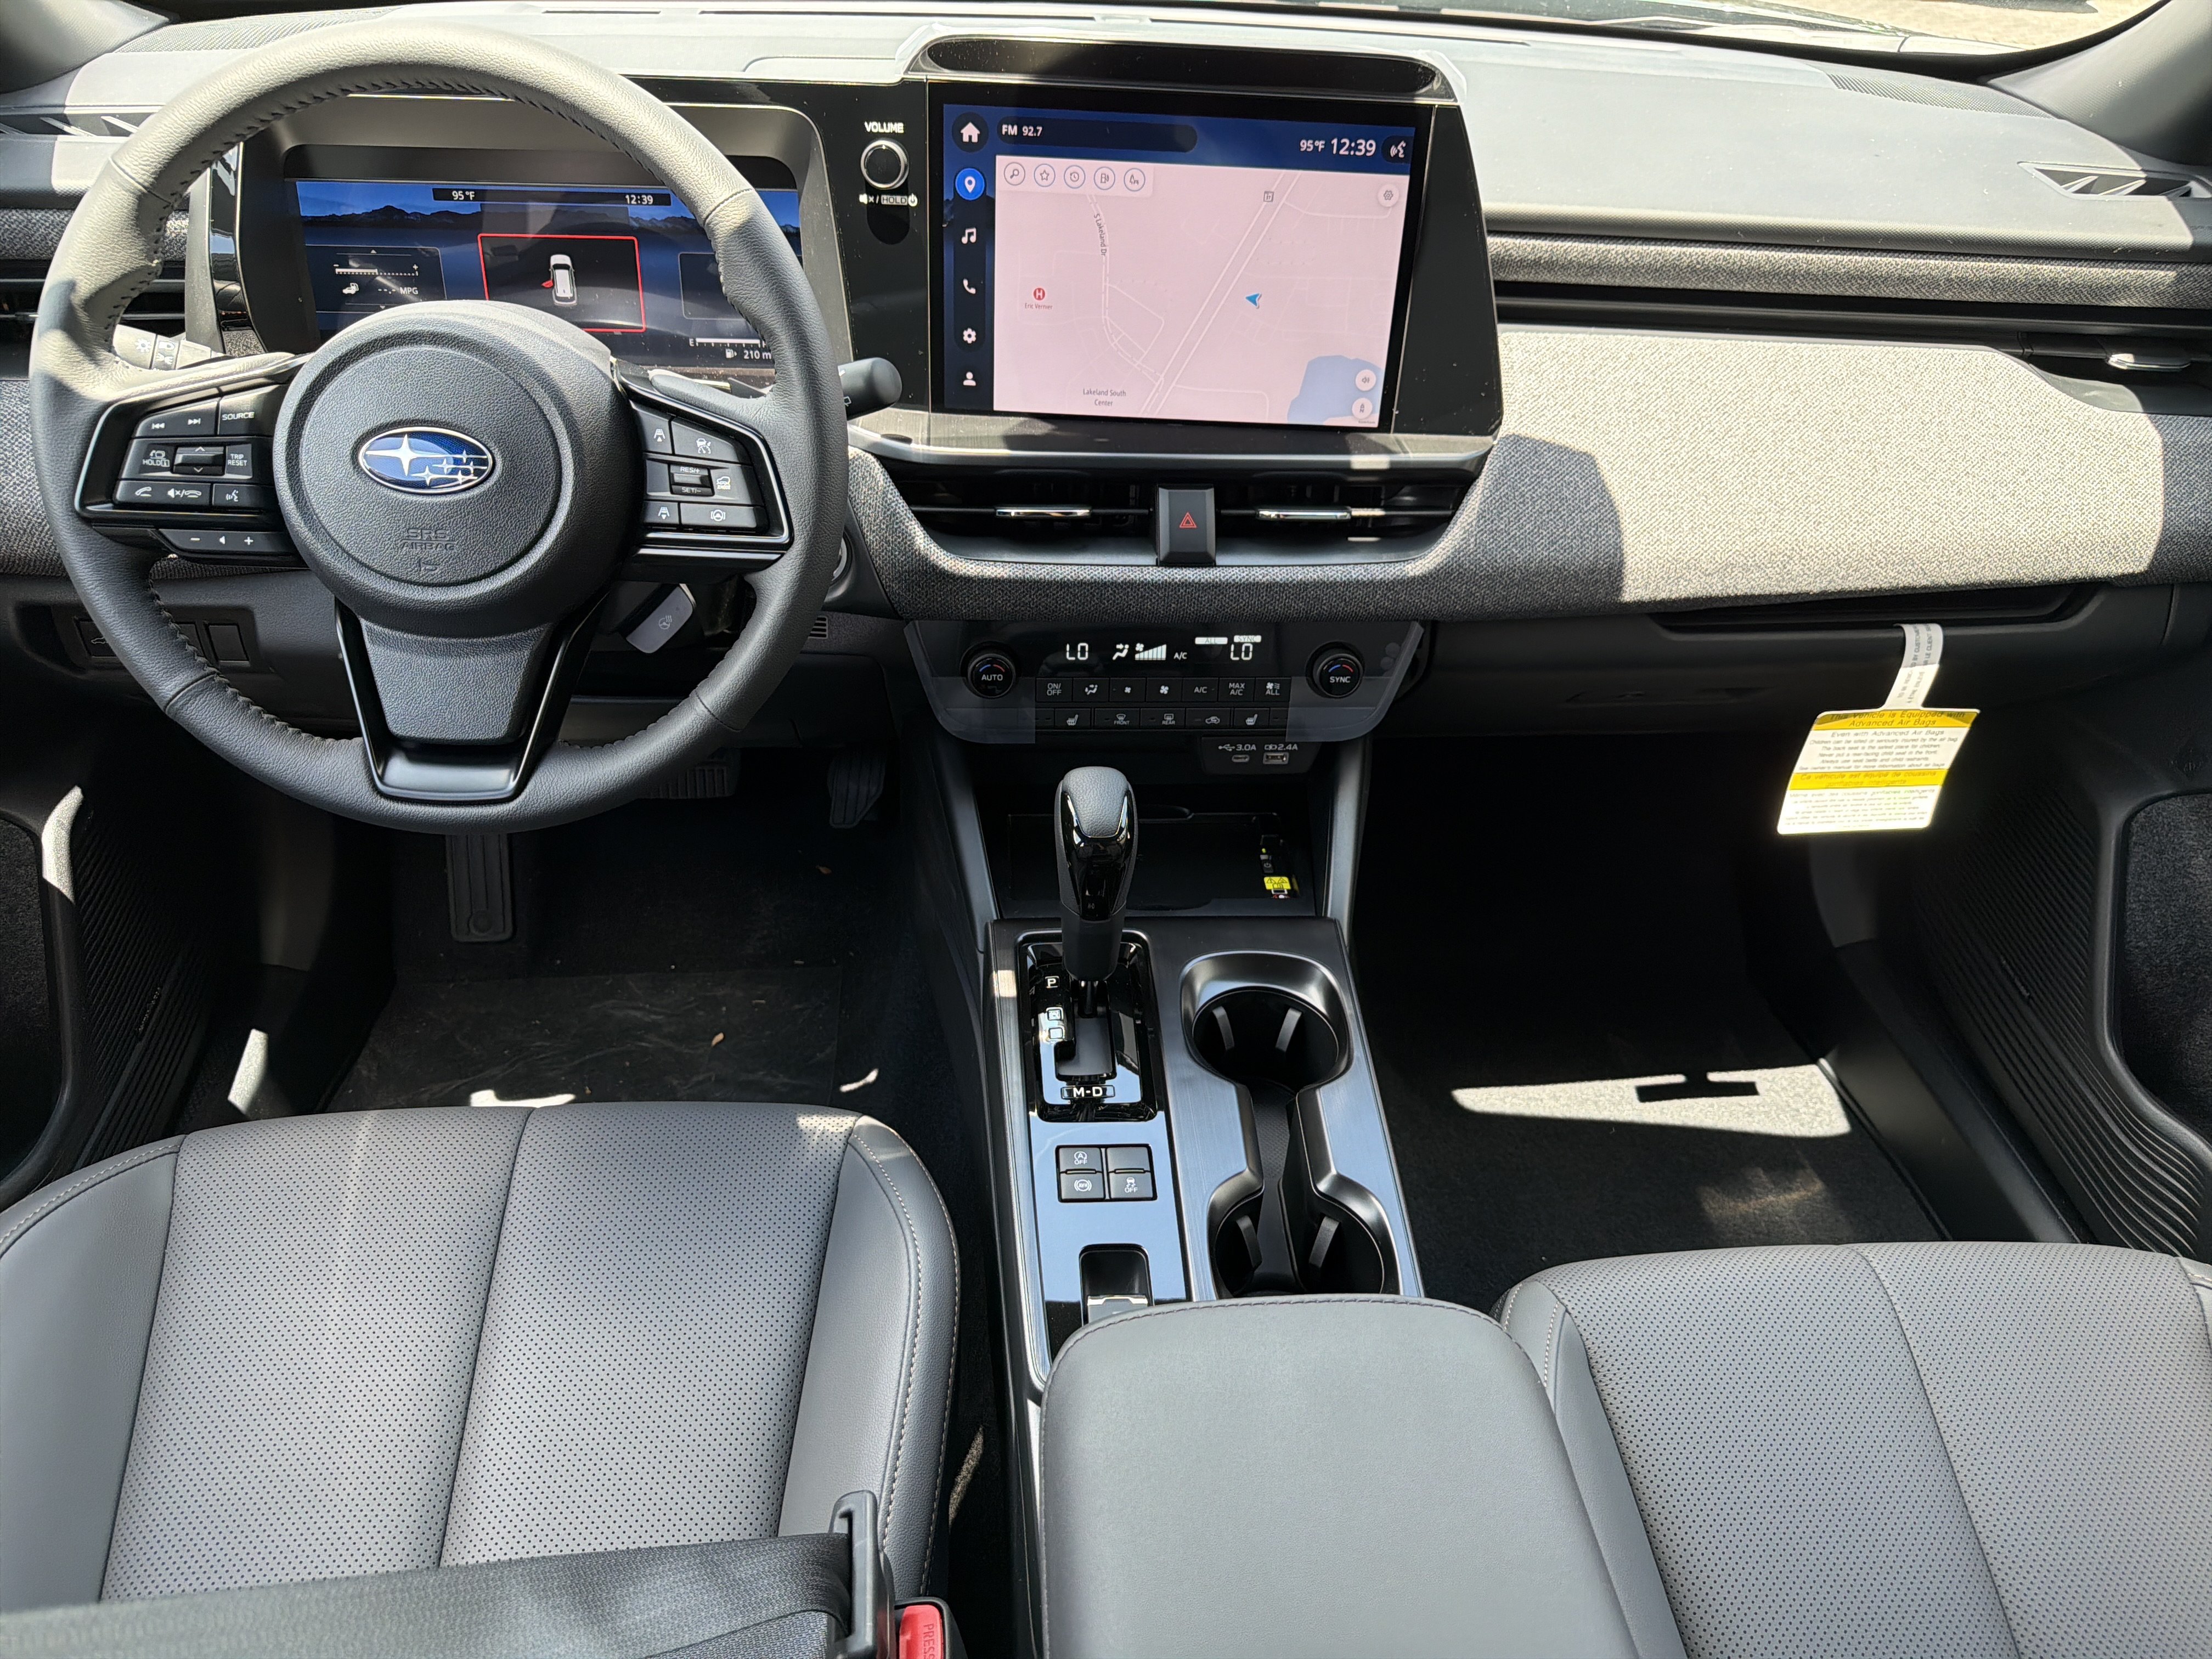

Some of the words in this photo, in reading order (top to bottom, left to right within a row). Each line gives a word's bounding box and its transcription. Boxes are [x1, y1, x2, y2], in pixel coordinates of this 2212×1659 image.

[864, 121, 904, 133] VOLUME
[1002, 124, 1018, 136] FM
[1022, 126, 1042, 137] 92.7
[1300, 139, 1325, 152] 95°F
[1331, 138, 1376, 156] 12:39
[625, 194, 653, 205] 12:39
[1096, 219, 1107, 247] Lakeland
[1101, 249, 1107, 257] Dr
[399, 286, 419, 295] MPG
[689, 338, 695, 347] E
[743, 350, 760, 359] 210
[1082, 388, 1109, 396] Lakeland
[222, 411, 255, 421] SOURCE
[407, 528, 449, 540] SRS
[402, 541, 456, 550] AIRBAG
[1066, 642, 1089, 661] LO
[1173, 651, 1188, 660] A/C
[1231, 643, 1253, 661] LO
[1900, 711, 1945, 720] Equipped
[1914, 719, 1937, 727] Bags
[1048, 978, 1057, 987] P
[1073, 1086, 1103, 1097] M-D
